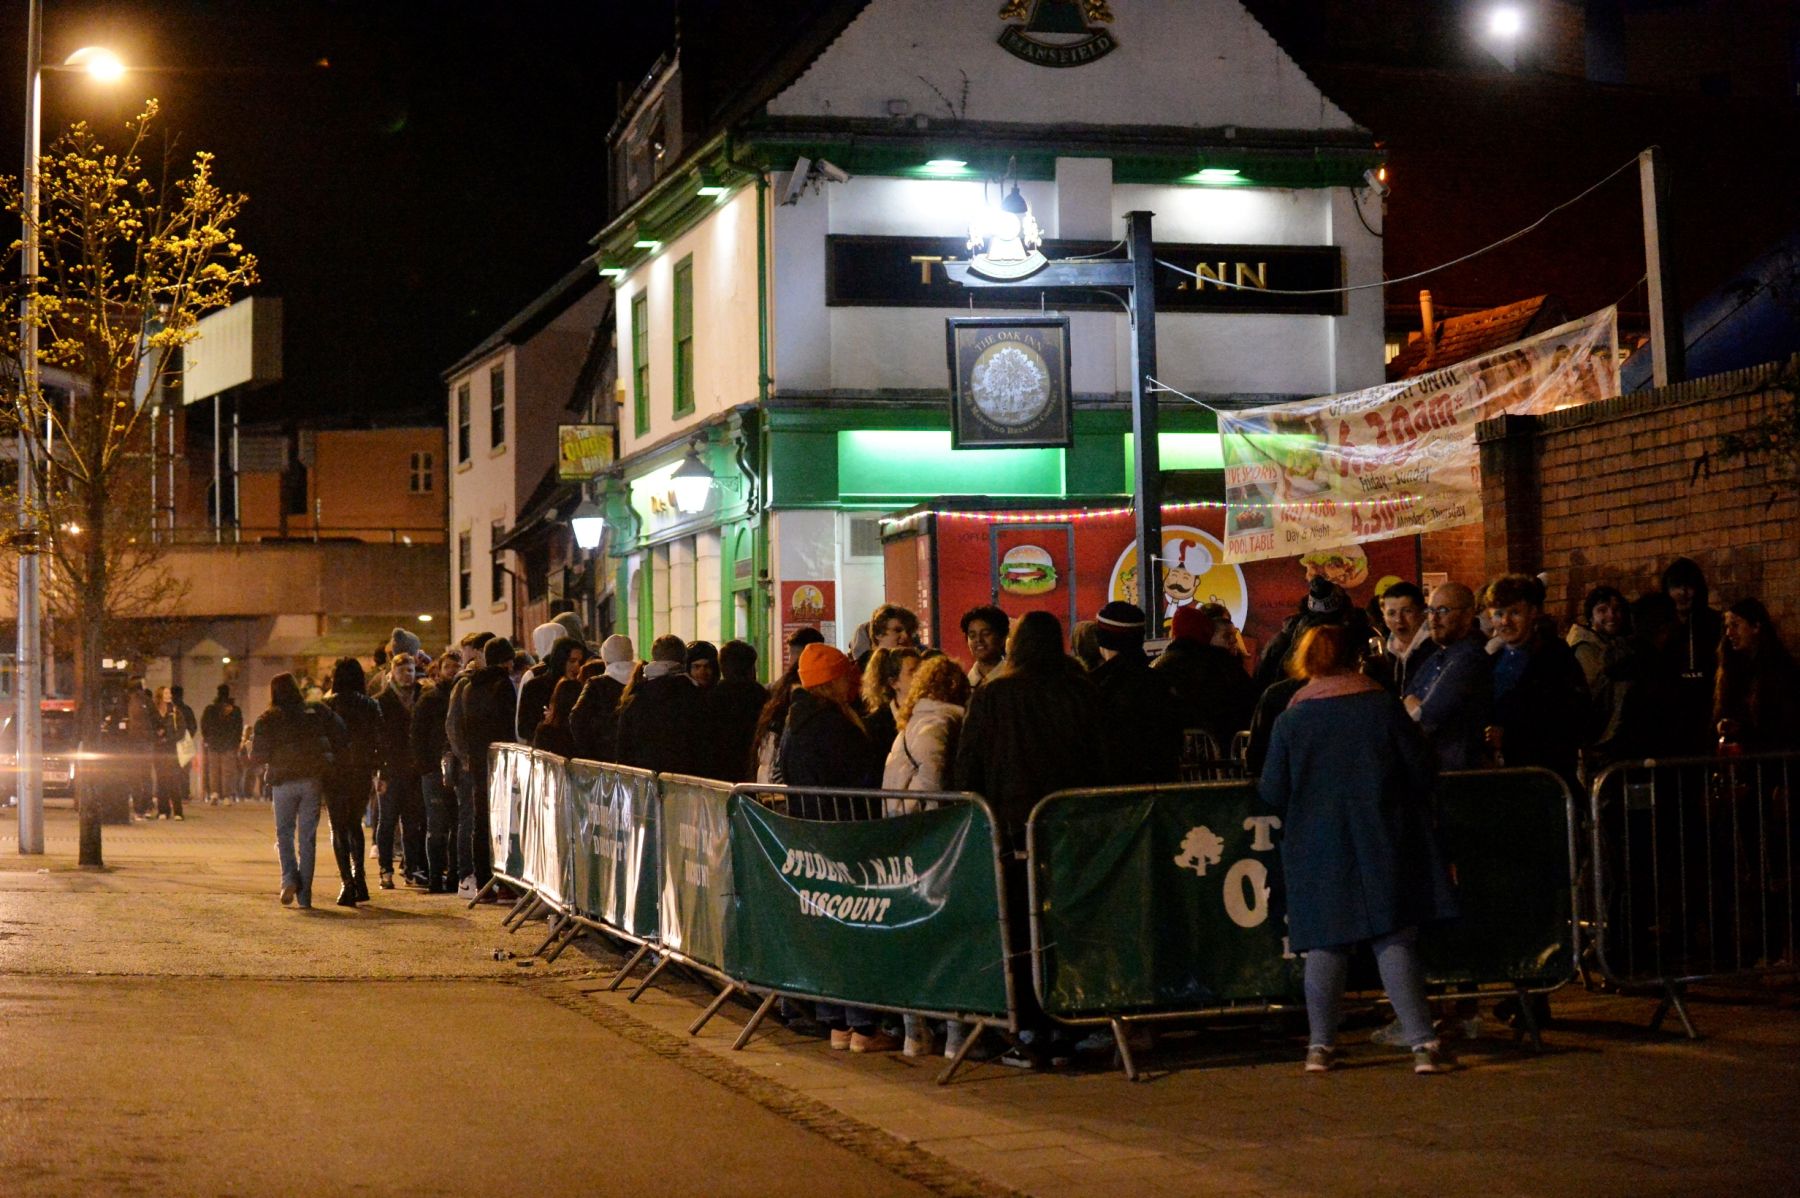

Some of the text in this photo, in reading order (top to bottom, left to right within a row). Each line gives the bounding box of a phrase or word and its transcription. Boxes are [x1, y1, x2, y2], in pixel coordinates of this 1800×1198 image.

[1005, 32, 1111, 63] MANSFIELD
[1175, 262, 1268, 292] NN
[997, 331, 1021, 341] OAK
[1358, 461, 1432, 493] Friday Sunday
[1229, 533, 1275, 555] POOL TABLE
[1286, 529, 1299, 544] Day
[1310, 523, 1330, 540] Night
[798, 889, 892, 923] DISCOUNT
